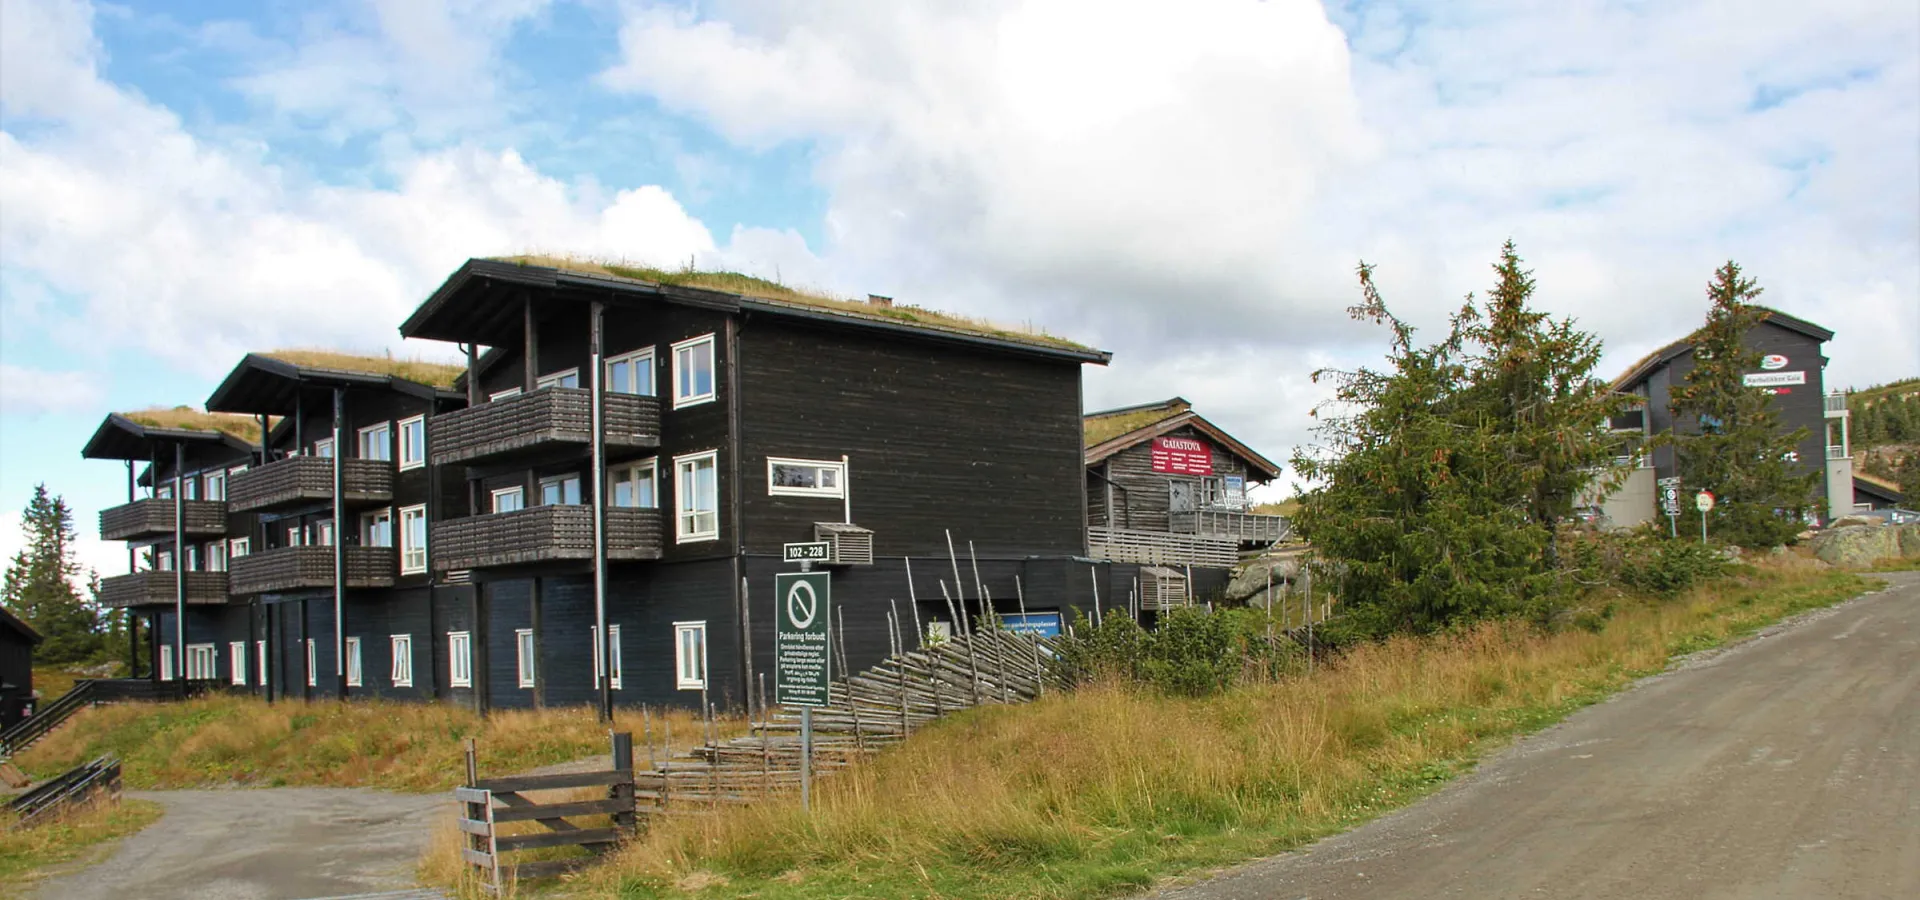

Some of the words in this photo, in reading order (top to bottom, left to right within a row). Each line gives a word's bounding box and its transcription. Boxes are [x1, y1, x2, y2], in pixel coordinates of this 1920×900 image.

[1162, 439, 1201, 451] GAIASTOVA
[789, 547, 802, 558] 102
[809, 546, 823, 557] 228
[779, 631, 804, 642] Parkering
[805, 631, 826, 641] forbudt
